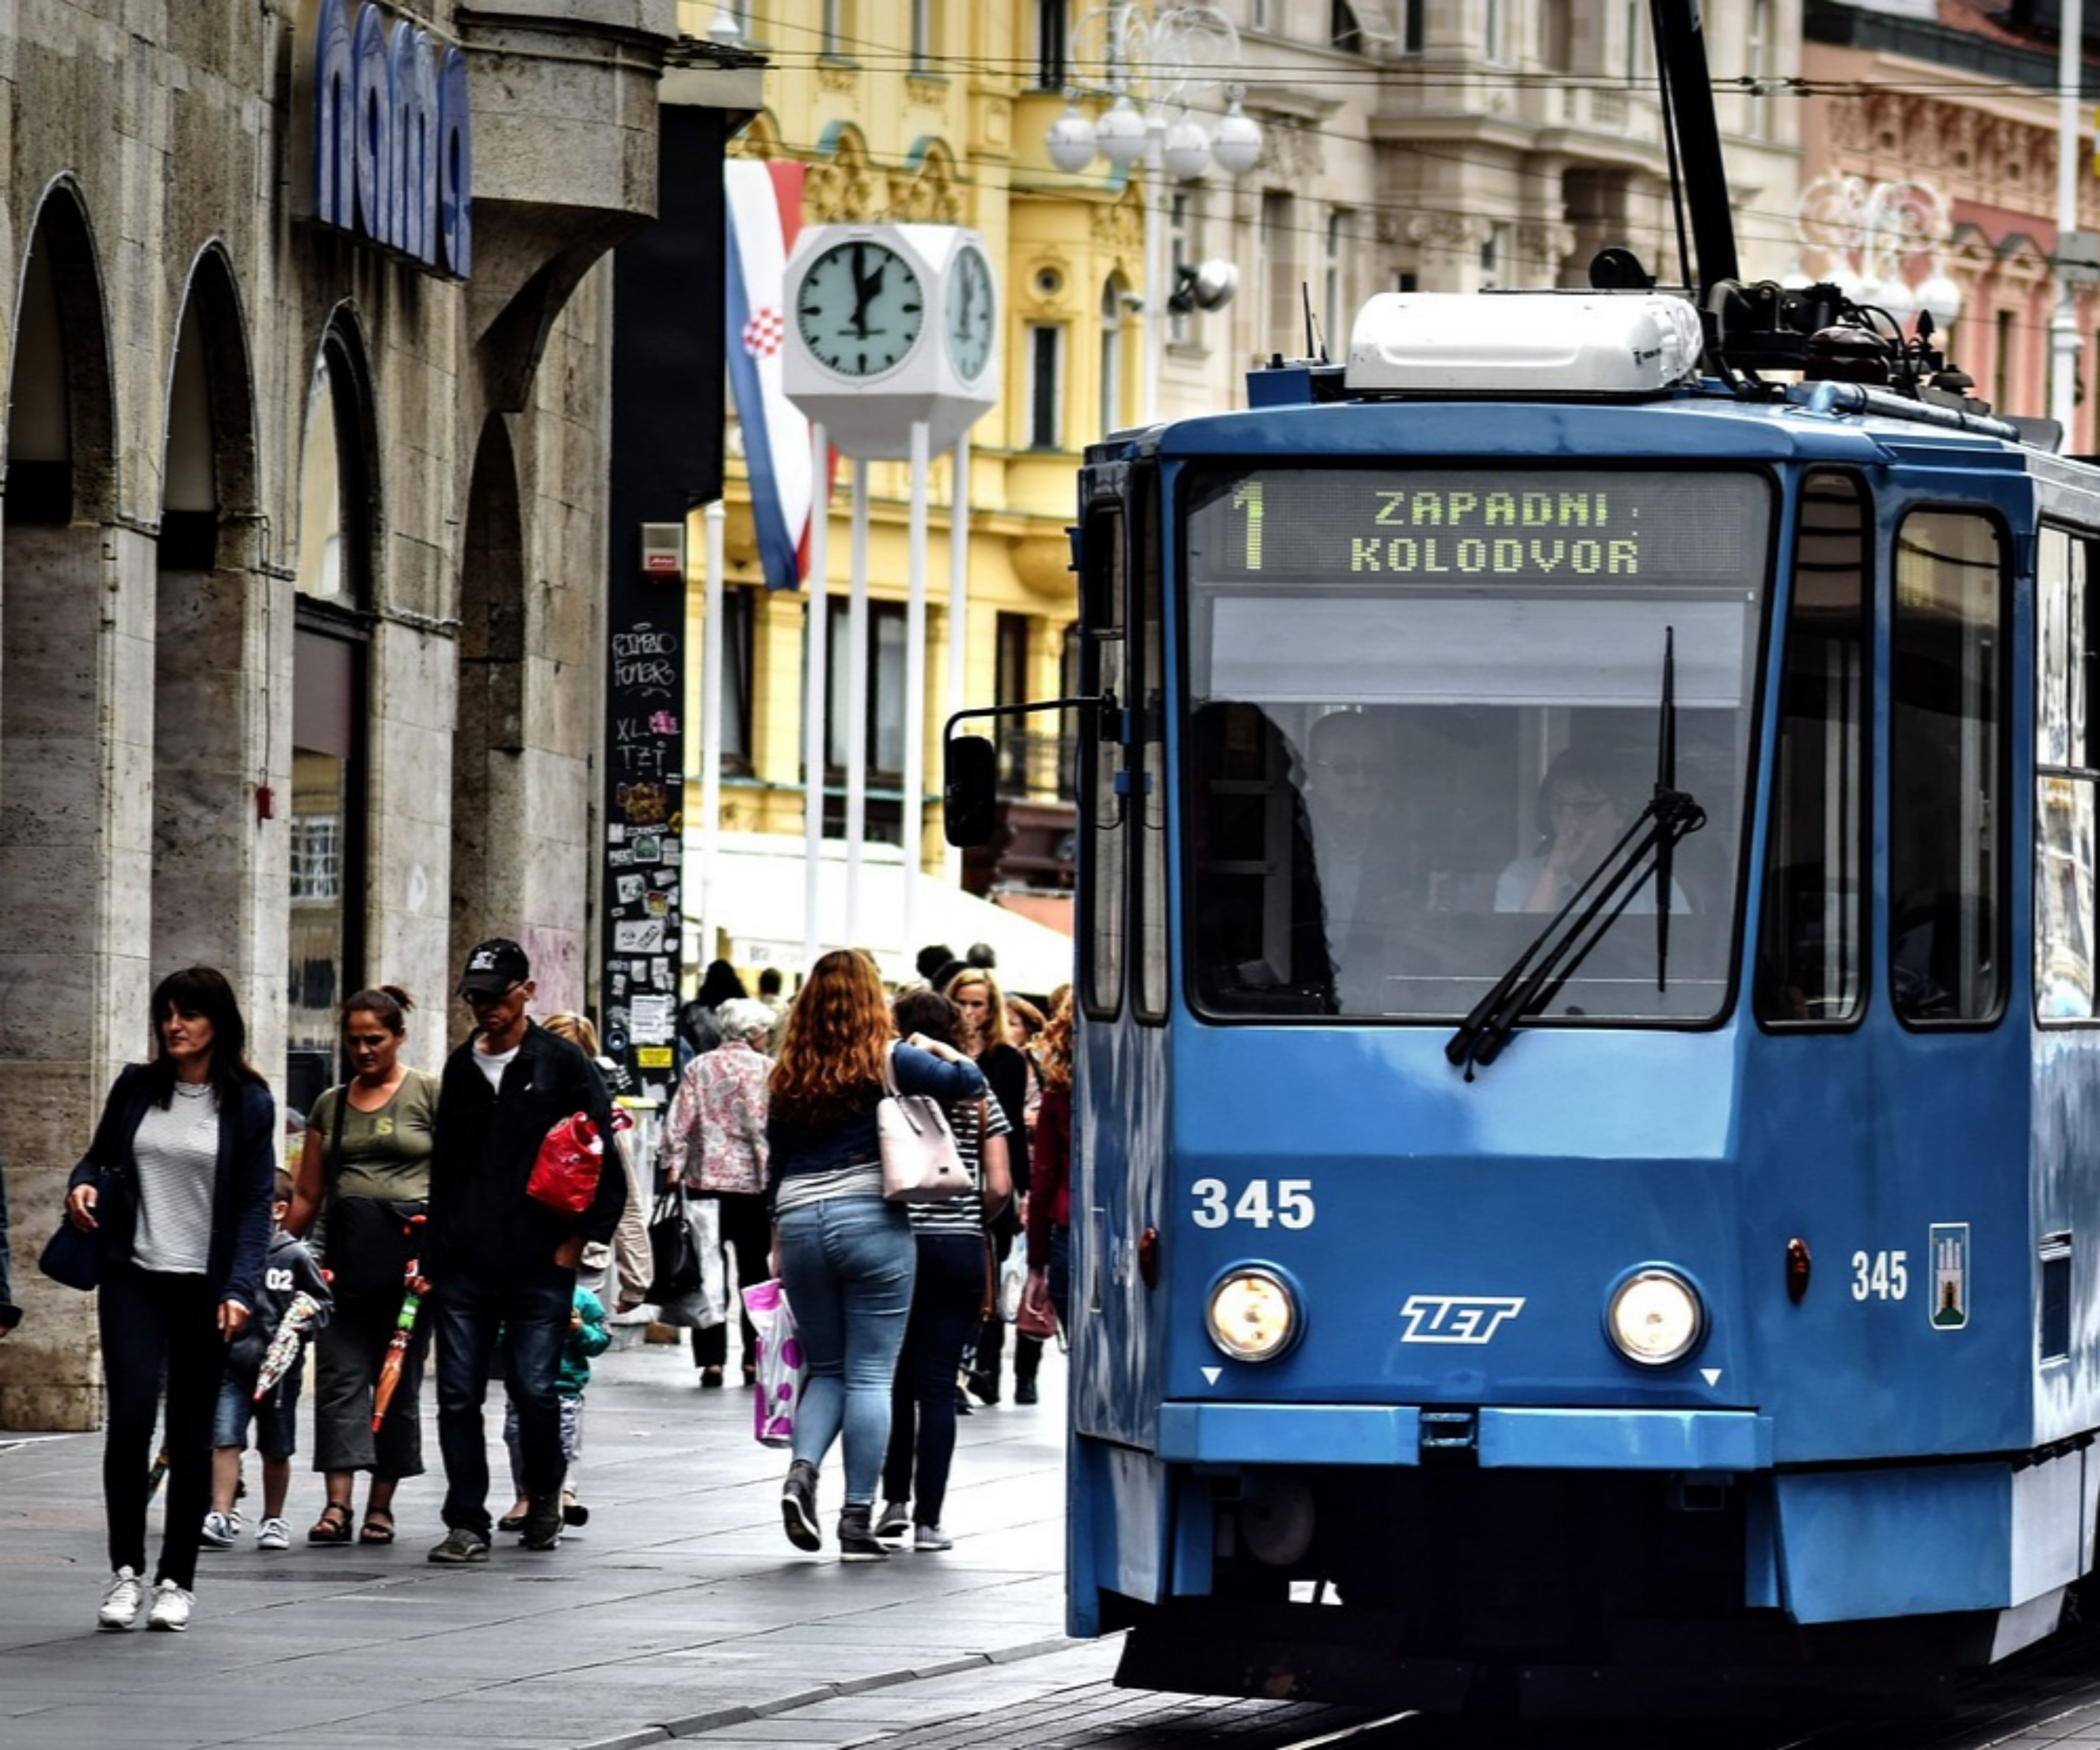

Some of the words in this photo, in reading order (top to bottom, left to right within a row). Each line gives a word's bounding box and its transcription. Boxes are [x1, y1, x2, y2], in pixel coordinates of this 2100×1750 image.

[1232, 481, 1264, 570] 1
[1375, 492, 1607, 526] ZAPADNI
[1351, 539, 1638, 573] KOLODVOR
[1191, 1178, 1315, 1229] 345
[266, 1267, 293, 1291] 02
[1851, 1250, 1907, 1301] 345
[1399, 1295, 1526, 1344] ZET
